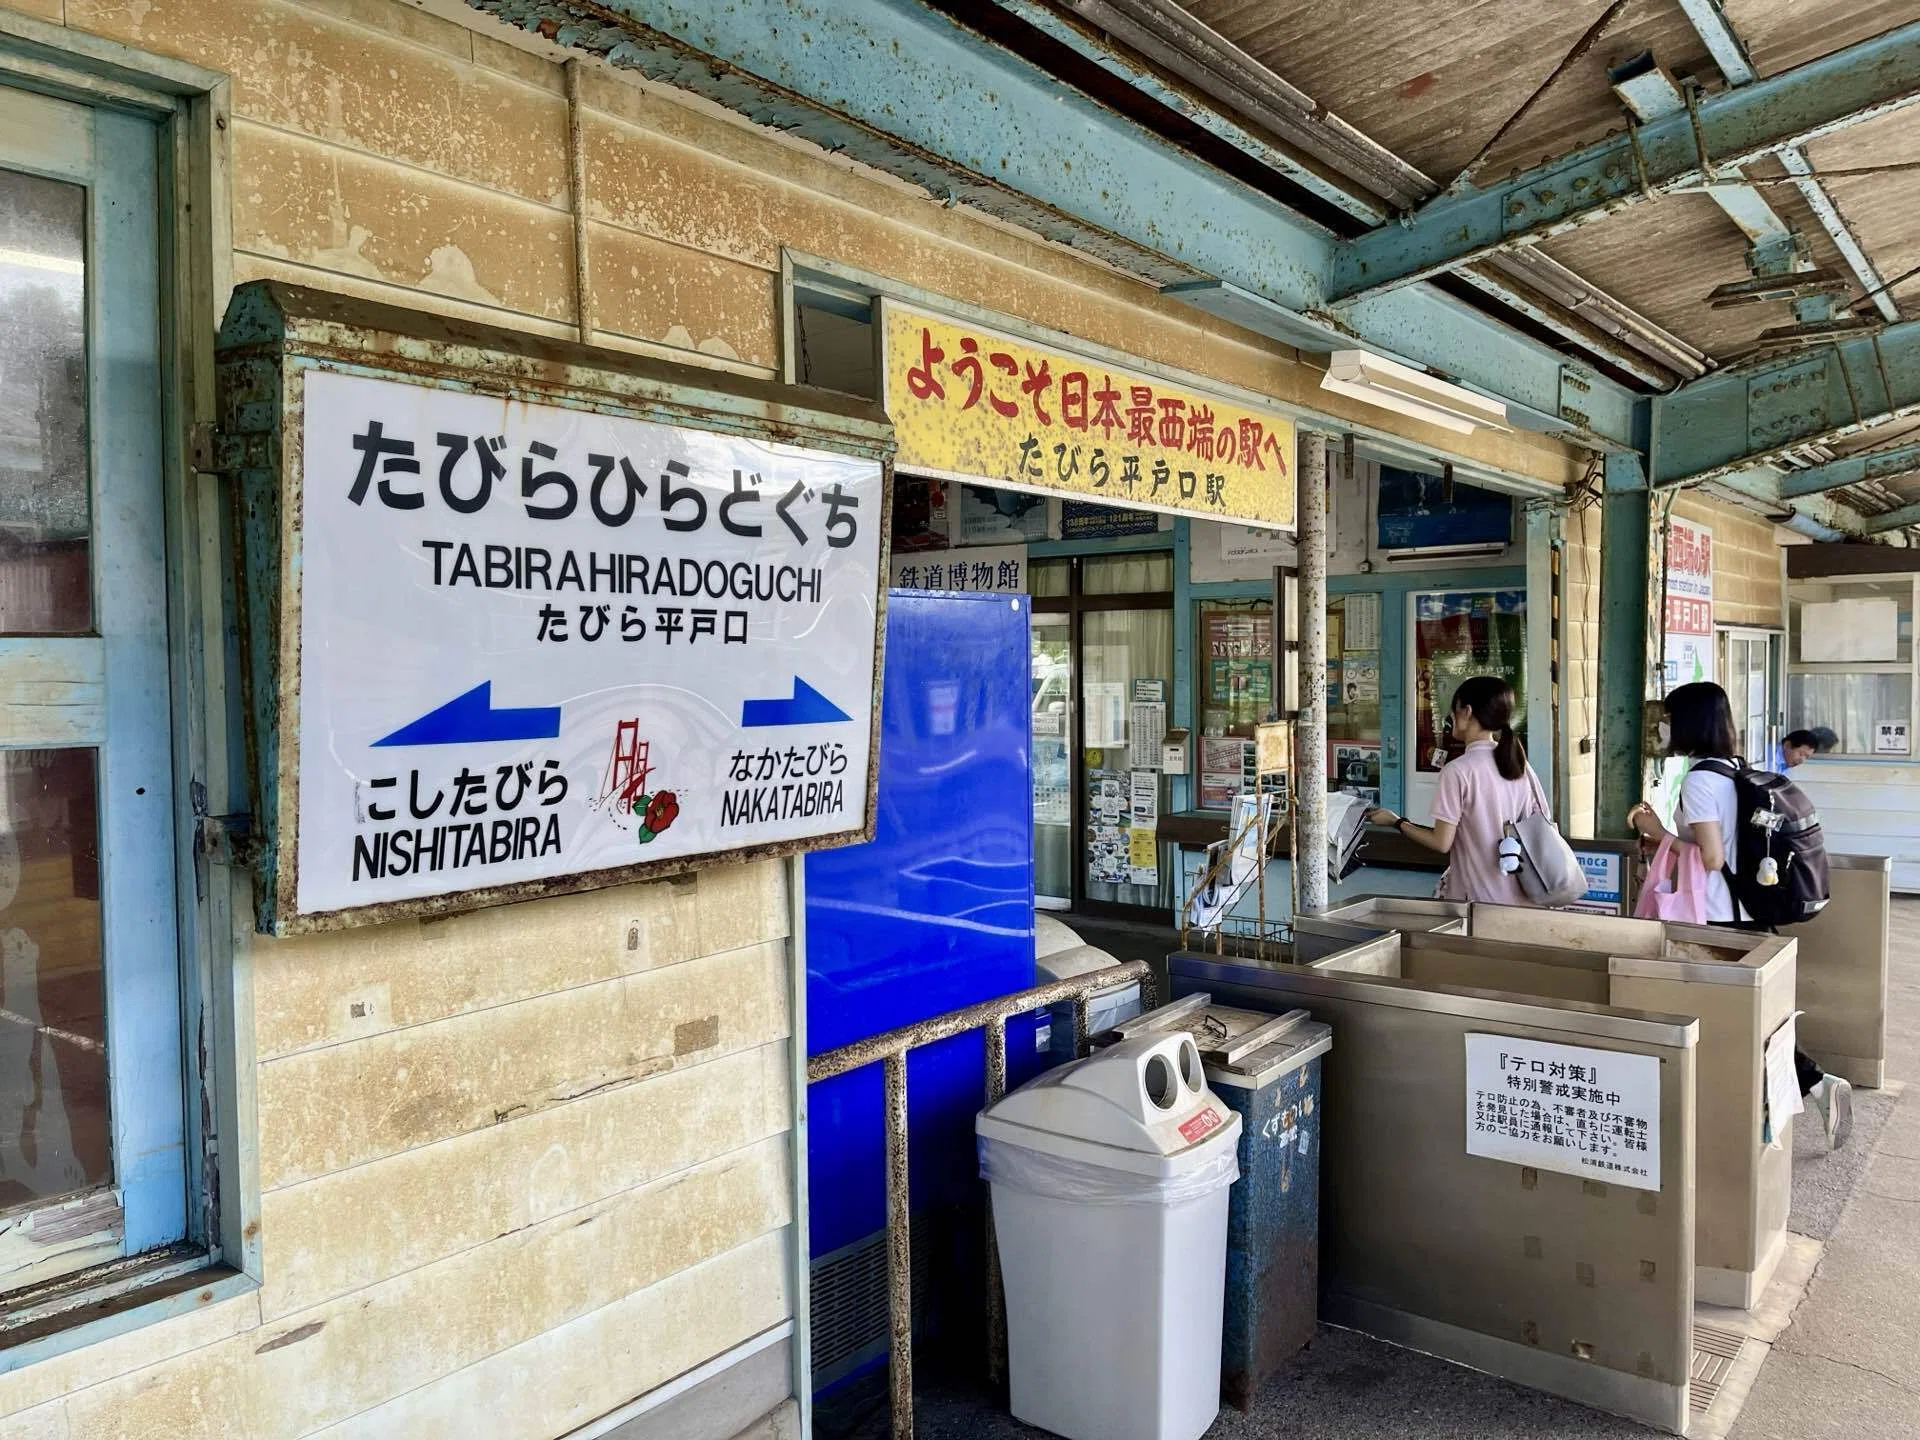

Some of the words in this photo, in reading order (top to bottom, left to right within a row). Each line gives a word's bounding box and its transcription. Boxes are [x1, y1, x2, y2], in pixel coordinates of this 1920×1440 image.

[907, 327, 1287, 477] ようこそ日本最西端の駅へ
[347, 420, 859, 548] たびらひらどぐち
[1018, 432, 1226, 508] たびら平戸口駅
[422, 540, 822, 603] TABIRAHIRADOGUCHI
[898, 559, 1020, 591] 鉄道博物館
[537, 603, 749, 645] たびら平戸口
[730, 742, 849, 783] なかたびら
[721, 778, 844, 827] NAKATABIRA
[352, 813, 562, 882] NISHITABIRA
[1498, 1053, 1598, 1085] 『テロ対策』
[1506, 1074, 1621, 1106] 特別警戒実施中
